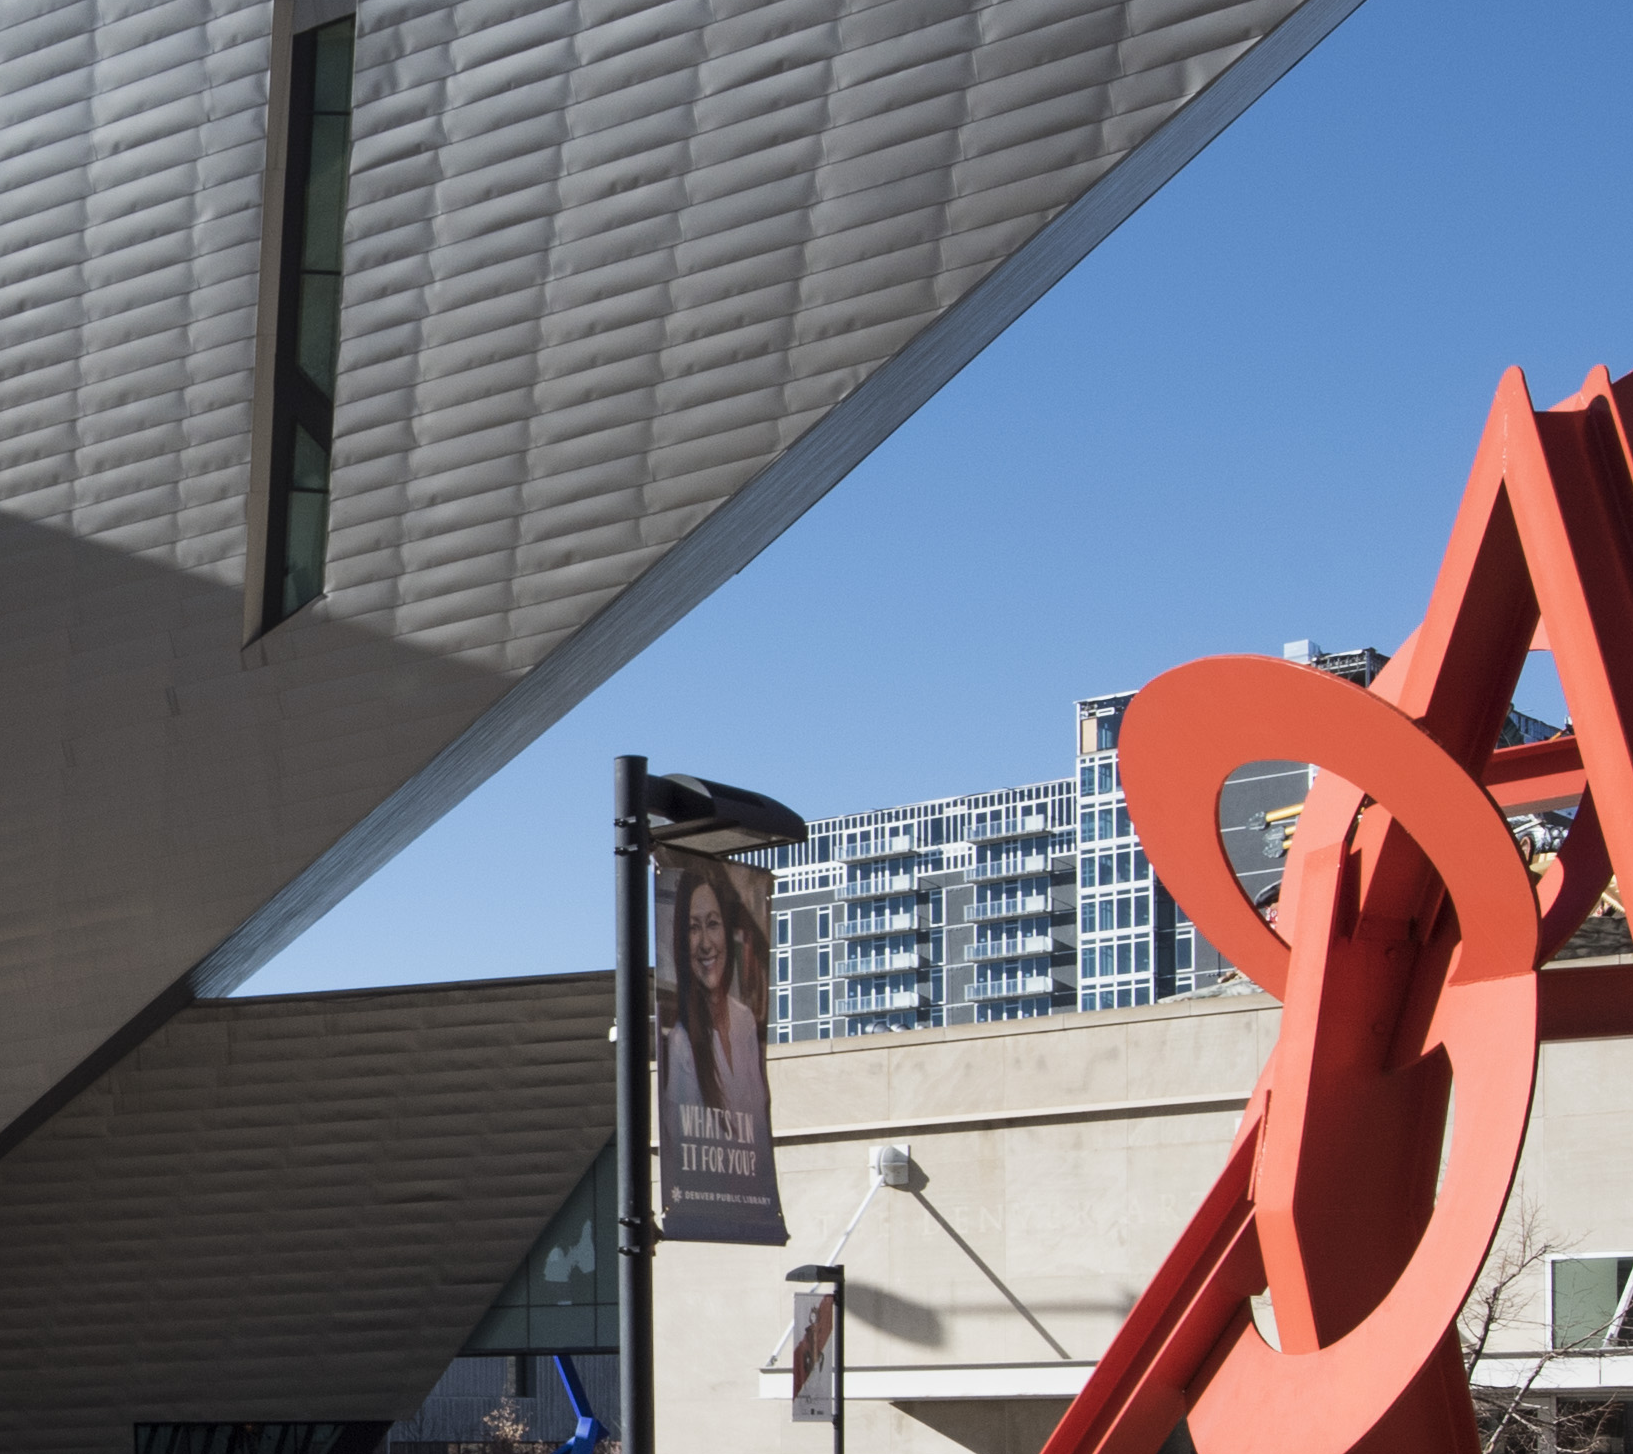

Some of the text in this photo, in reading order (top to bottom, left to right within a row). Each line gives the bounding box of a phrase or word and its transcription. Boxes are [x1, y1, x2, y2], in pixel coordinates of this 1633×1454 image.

[680, 1104, 755, 1144] WHAT'S IN
[681, 1143, 756, 1176] IT FOR YOU?
[685, 1191, 771, 1206] DENVER PUBLIC LIBRARY
[816, 1212, 891, 1238] TE
